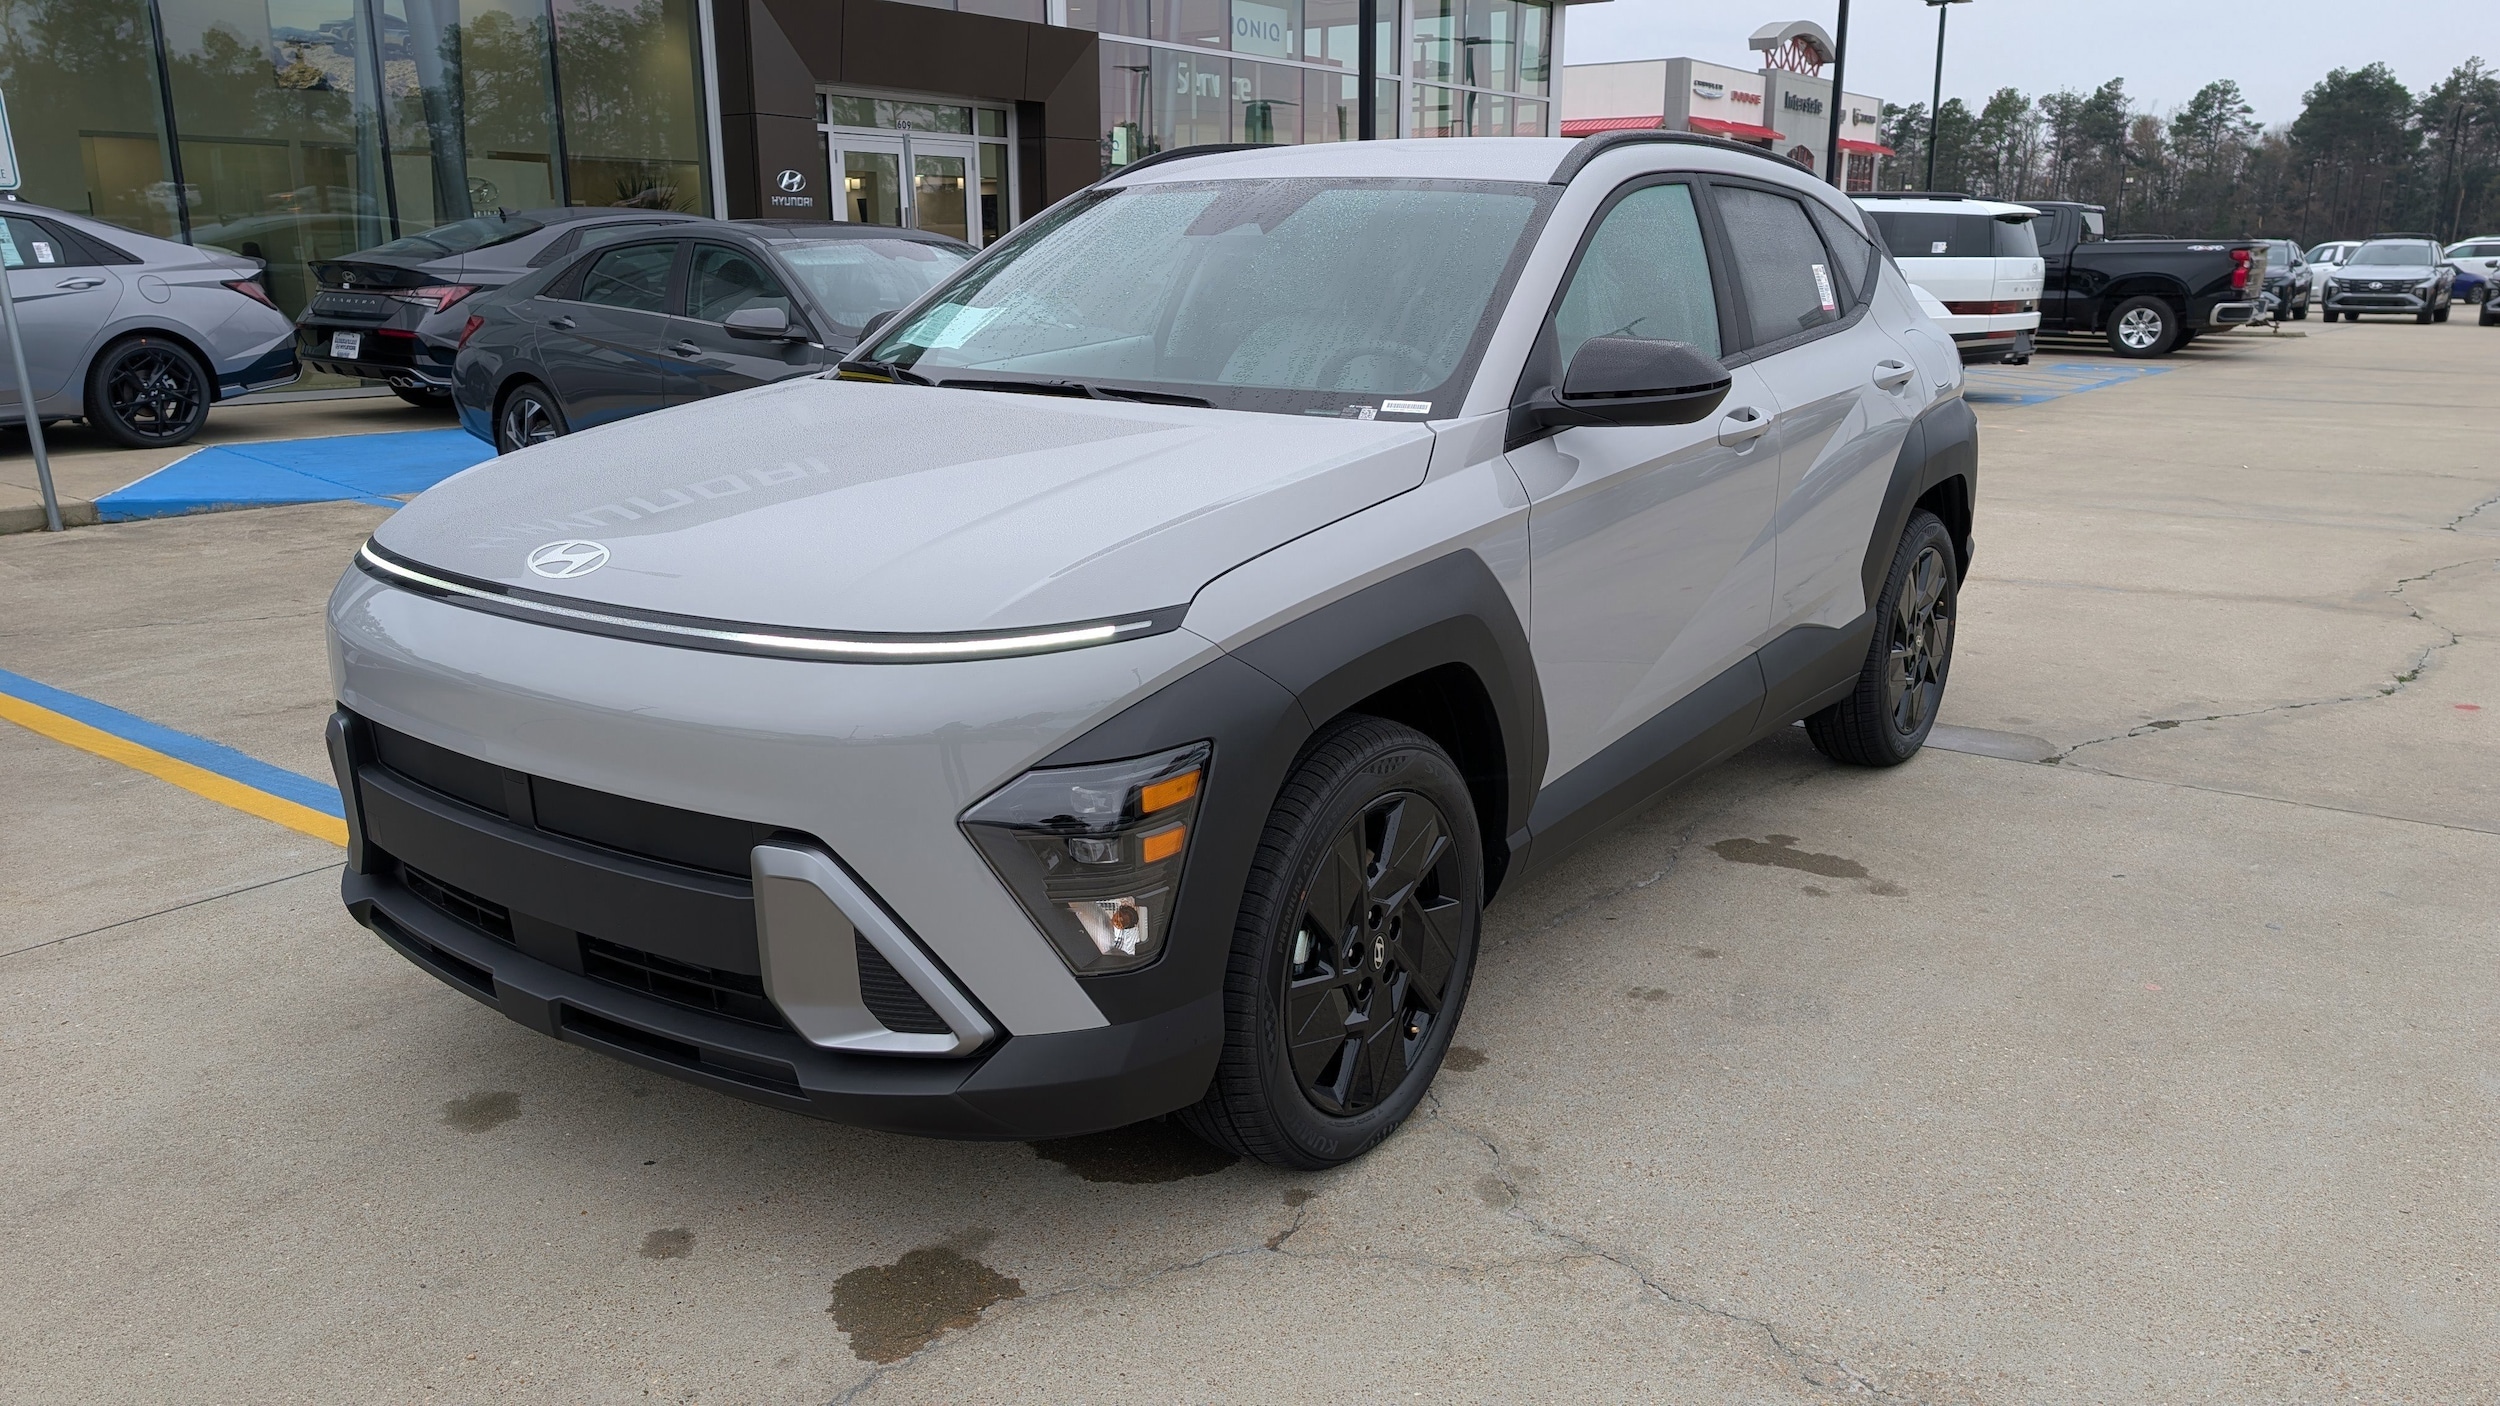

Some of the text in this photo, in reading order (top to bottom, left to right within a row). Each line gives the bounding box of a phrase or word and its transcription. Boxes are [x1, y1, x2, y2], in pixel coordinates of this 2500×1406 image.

[1177, 61, 1251, 101] Servce
[1785, 91, 1823, 113] Interstate
[897, 120, 912, 129] 609
[771, 196, 813, 207] HYUNDAI
[325, 296, 376, 305] ELANTRA
[1277, 878, 1304, 954] PREMIUM
